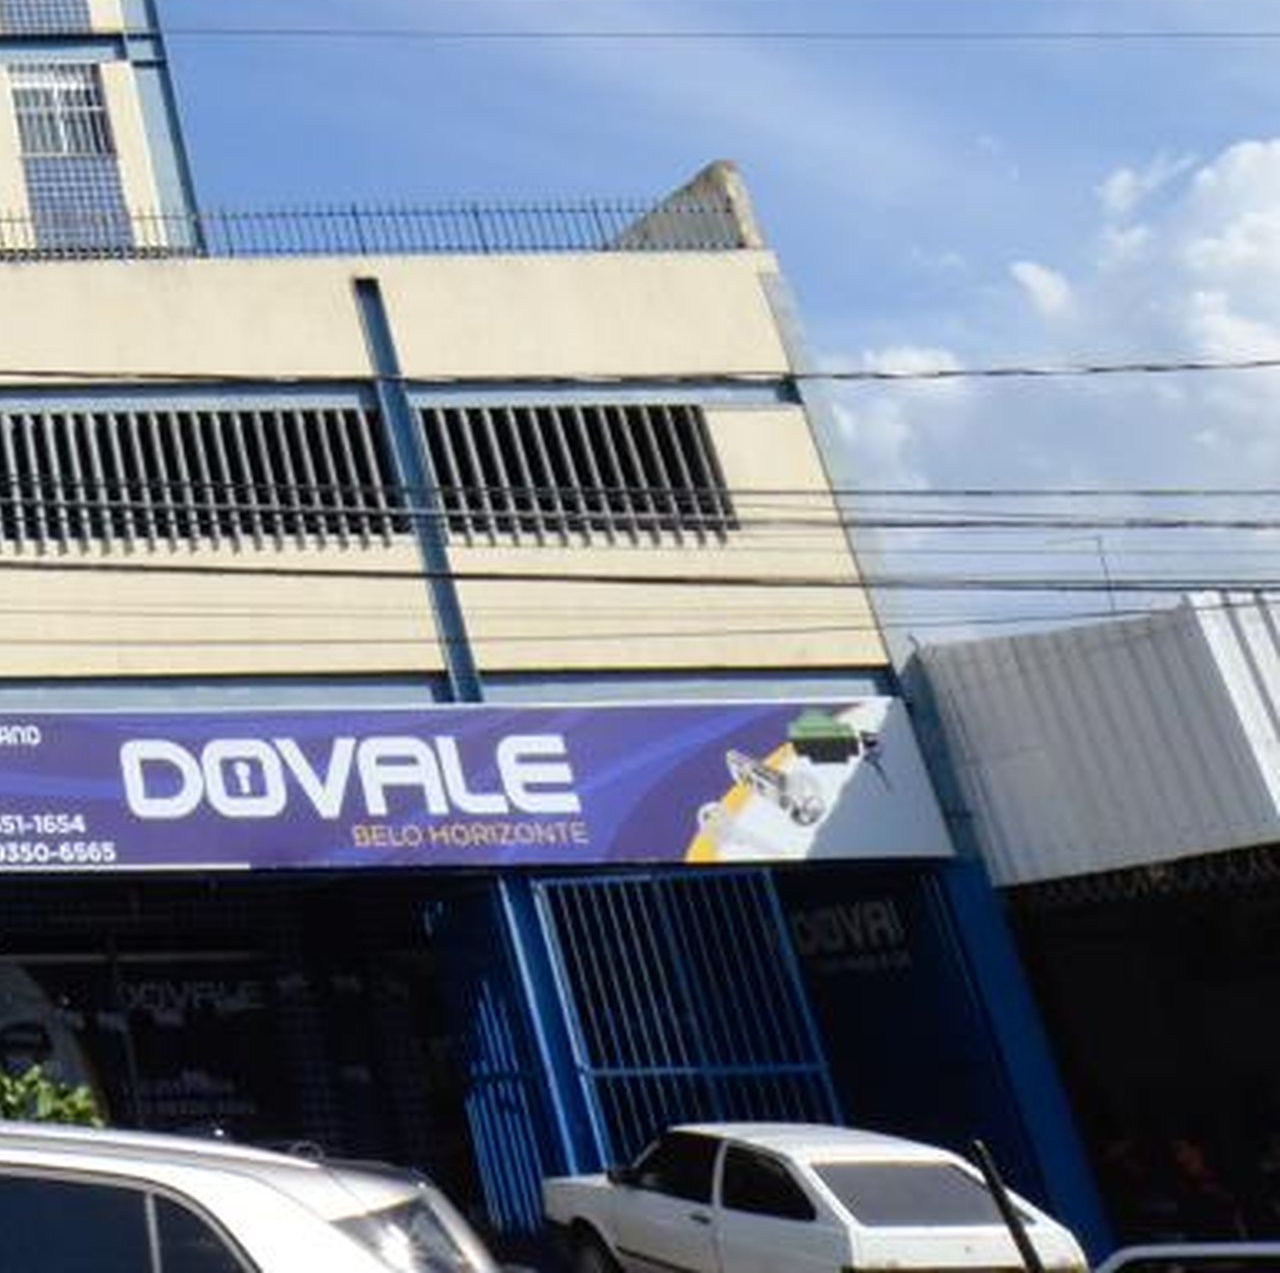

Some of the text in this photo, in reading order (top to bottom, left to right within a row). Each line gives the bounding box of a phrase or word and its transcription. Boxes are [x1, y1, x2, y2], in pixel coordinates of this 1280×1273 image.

[120, 735, 583, 819] DOVALE
[352, 822, 590, 849] BELO HORIZONTE
